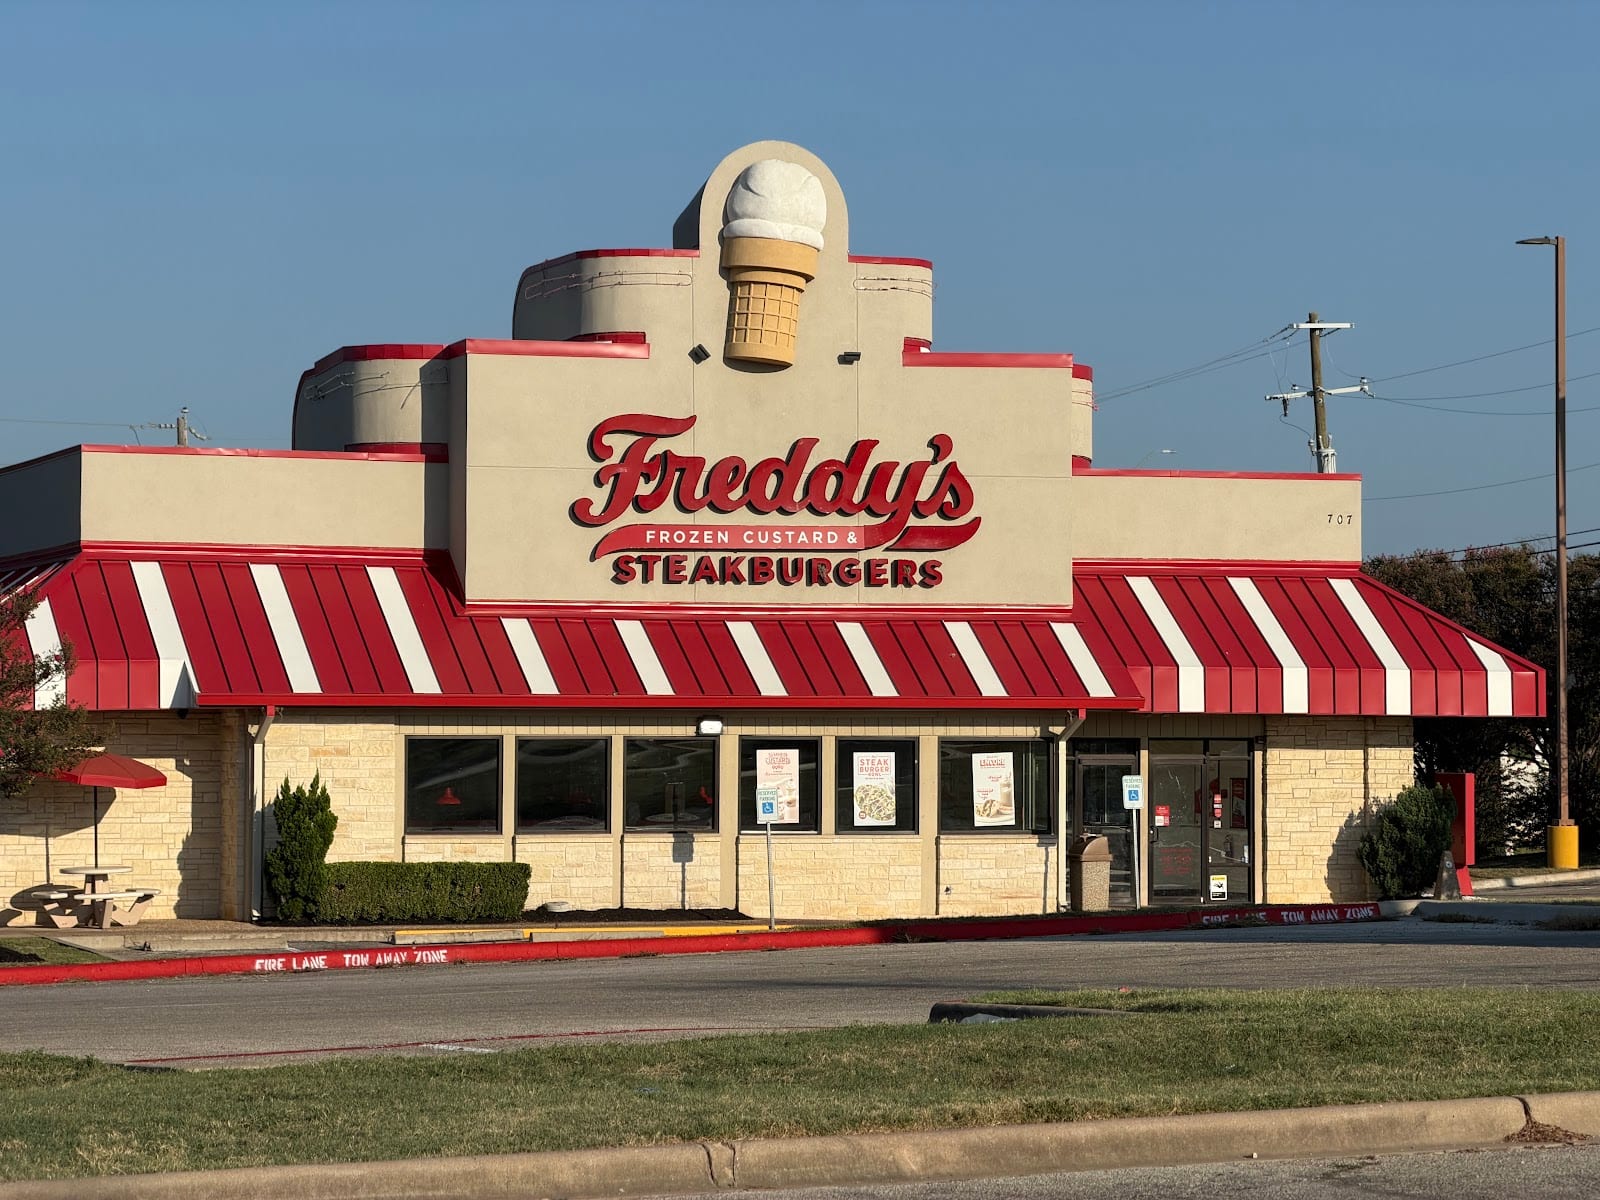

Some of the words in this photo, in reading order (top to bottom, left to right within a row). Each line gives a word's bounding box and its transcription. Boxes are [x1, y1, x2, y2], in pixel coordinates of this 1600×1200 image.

[569, 413, 978, 540] Freddy's
[1327, 514, 1353, 525] 707
[645, 530, 730, 544] FROZEN
[743, 530, 838, 544] CUSTARD
[846, 530, 858, 545] &
[610, 554, 944, 588] STEAKBURGERS
[859, 758, 889, 766] STEAK
[1281, 911, 1306, 923] TOW
[1311, 909, 1340, 921] AWAY
[1344, 906, 1374, 918] ZONE
[255, 958, 287, 972] FIRE
[292, 955, 329, 970] LANE
[343, 954, 370, 968] TOW
[375, 952, 408, 965] AWAY
[414, 949, 448, 964] ZONE
